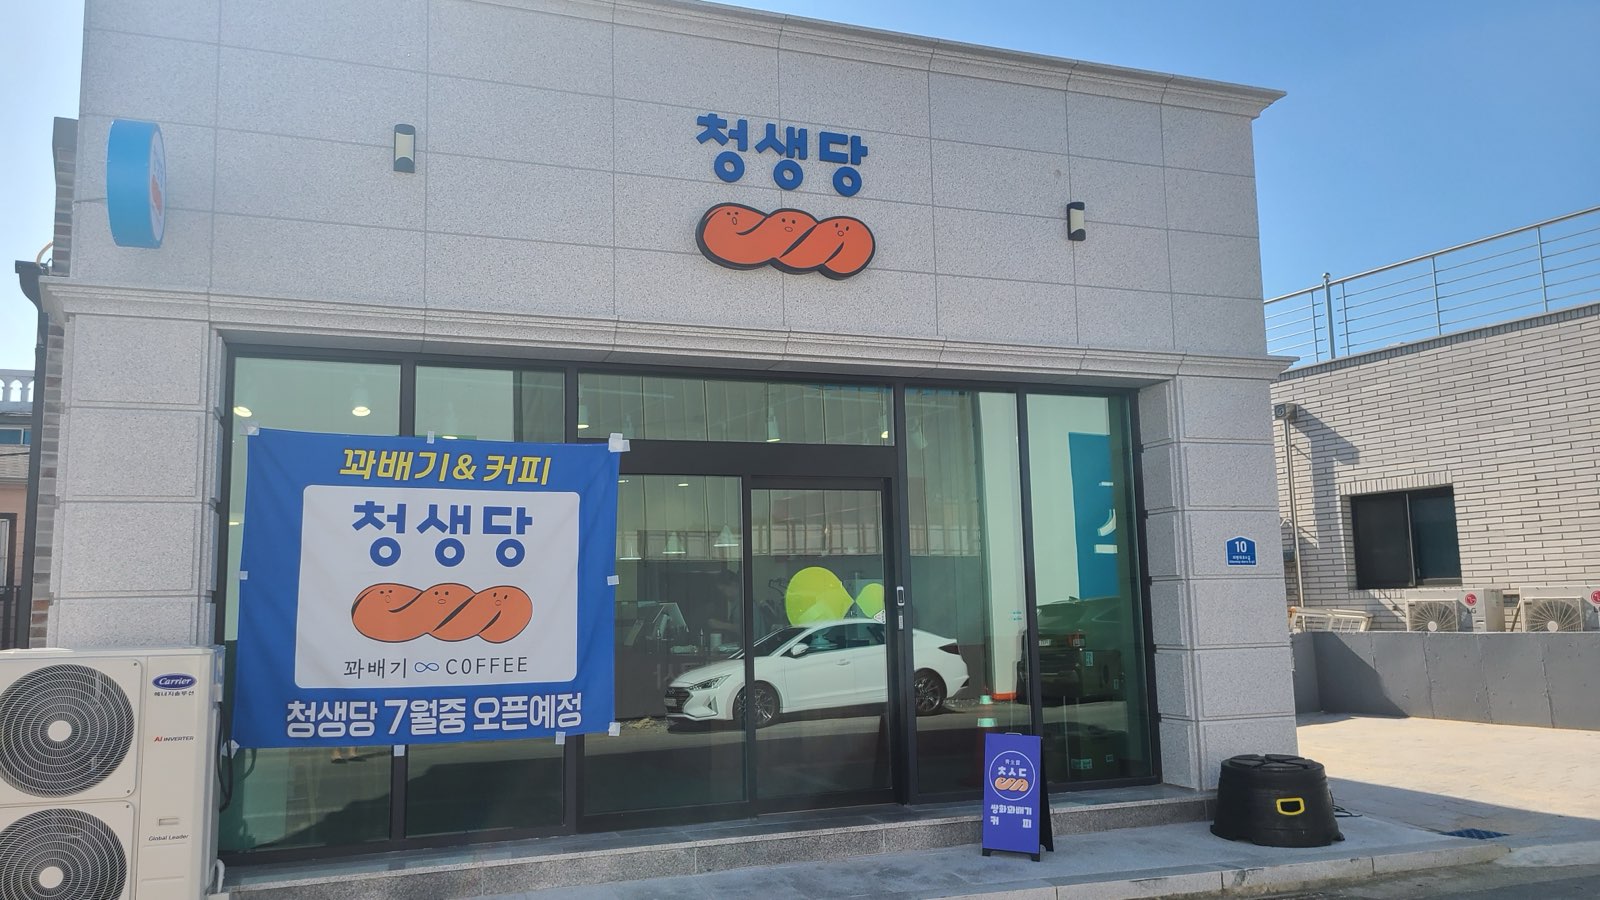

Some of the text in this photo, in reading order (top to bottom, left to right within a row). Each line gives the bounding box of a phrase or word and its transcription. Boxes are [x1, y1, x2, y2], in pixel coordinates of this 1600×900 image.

[695, 112, 869, 198] 청생당
[351, 500, 533, 567] 청생당
[1235, 541, 1247, 553] 10
[159, 677, 192, 686] Carrier
[343, 657, 528, 680] 꽈배기 COFFEE
[286, 692, 582, 738] 청생당 7월중 오픈예정
